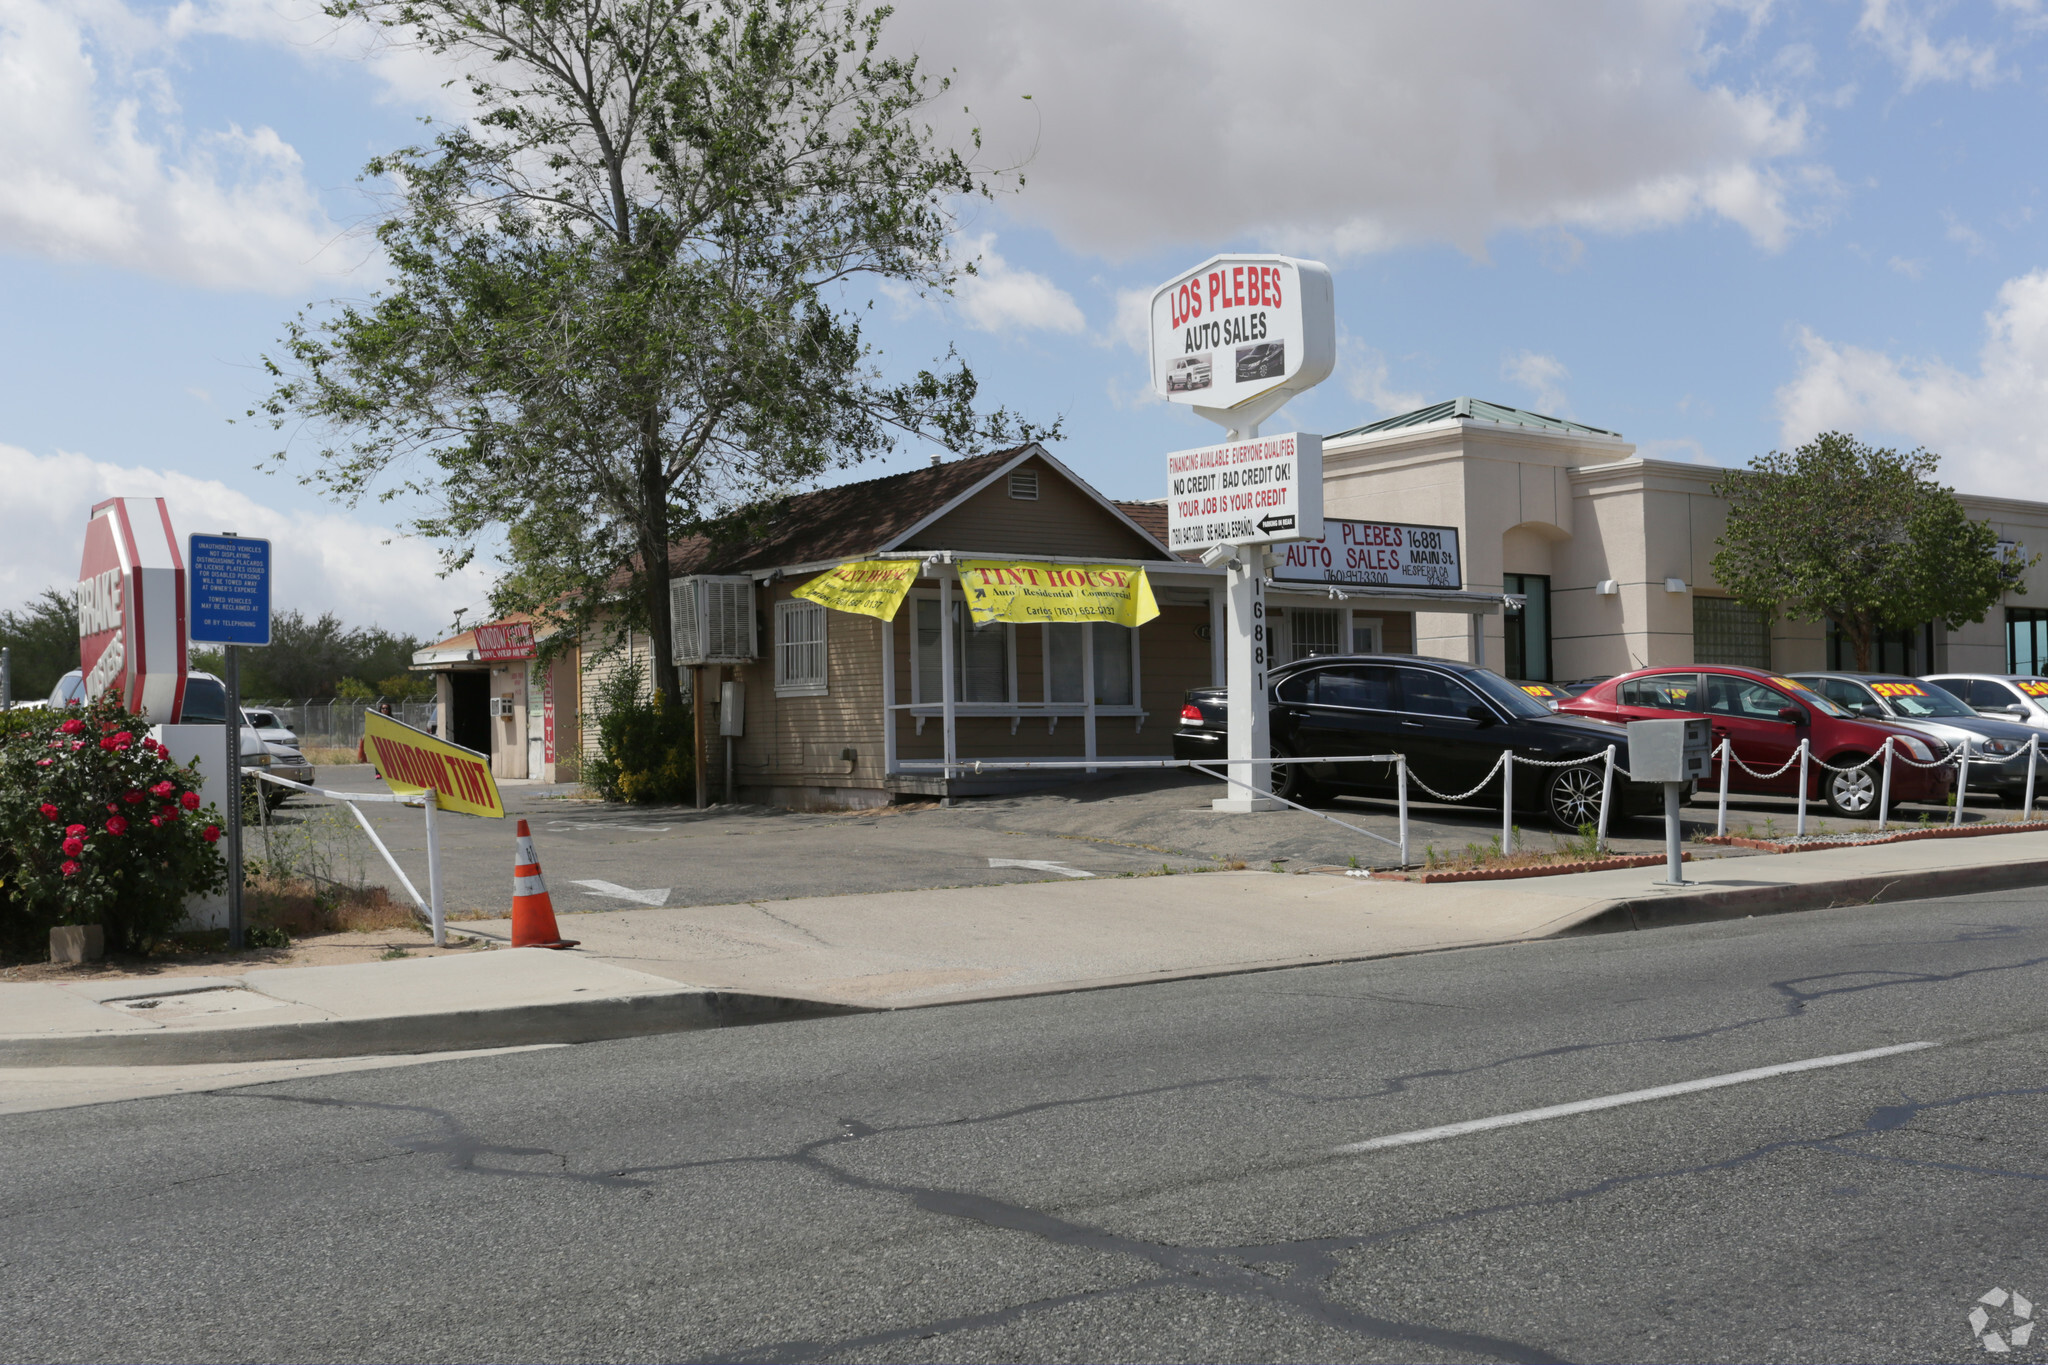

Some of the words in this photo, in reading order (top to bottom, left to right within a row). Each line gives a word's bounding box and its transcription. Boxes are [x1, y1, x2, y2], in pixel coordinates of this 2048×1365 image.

[1171, 278, 1202, 330] LOS
[1209, 266, 1281, 312] PLEBES
[1185, 320, 1220, 353] AUTO
[1224, 311, 1267, 345] SALES
[1170, 456, 1199, 474] FINANCING
[1200, 448, 1229, 469] AVAILABLE
[1232, 443, 1263, 464] EVERYONE
[1264, 438, 1294, 459] QUALIFIES
[1173, 479, 1184, 496] NO
[1187, 474, 1216, 493] CREDIT
[1223, 470, 1239, 489] BAD
[1242, 465, 1273, 486] CREDIT
[1275, 463, 1291, 482] OK!
[1178, 502, 1199, 518] YOUR
[1201, 497, 1218, 515] JOB
[1220, 495, 1228, 512] IS
[1230, 492, 1253, 511] YOUR
[1255, 487, 1287, 508] CREDIT
[1207, 523, 1214, 541] SE
[1214, 521, 1231, 540] HABLA
[1231, 516, 1255, 537] ESPAÑOL
[1342, 523, 1403, 547] PLEBES
[1407, 530, 1442, 550] 16881
[199, 543, 236, 551] UNAUTHORIZED
[1286, 545, 1332, 568] AUTO
[1346, 547, 1400, 570] SALES
[1410, 550, 1439, 565] MAIN
[974, 567, 1039, 586] TINT
[1046, 569, 1131, 588] HOUSE
[78, 567, 122, 637] BRAKE
[993, 588, 1015, 596] Auto
[1023, 588, 1074, 599] Residential
[1081, 589, 1131, 600] Commercial
[1026, 606, 1053, 616] Carlos
[1054, 607, 1078, 617] (760)
[475, 627, 506, 650] WINDOW
[370, 734, 454, 797] WINDOW
[443, 754, 495, 809] TINT
